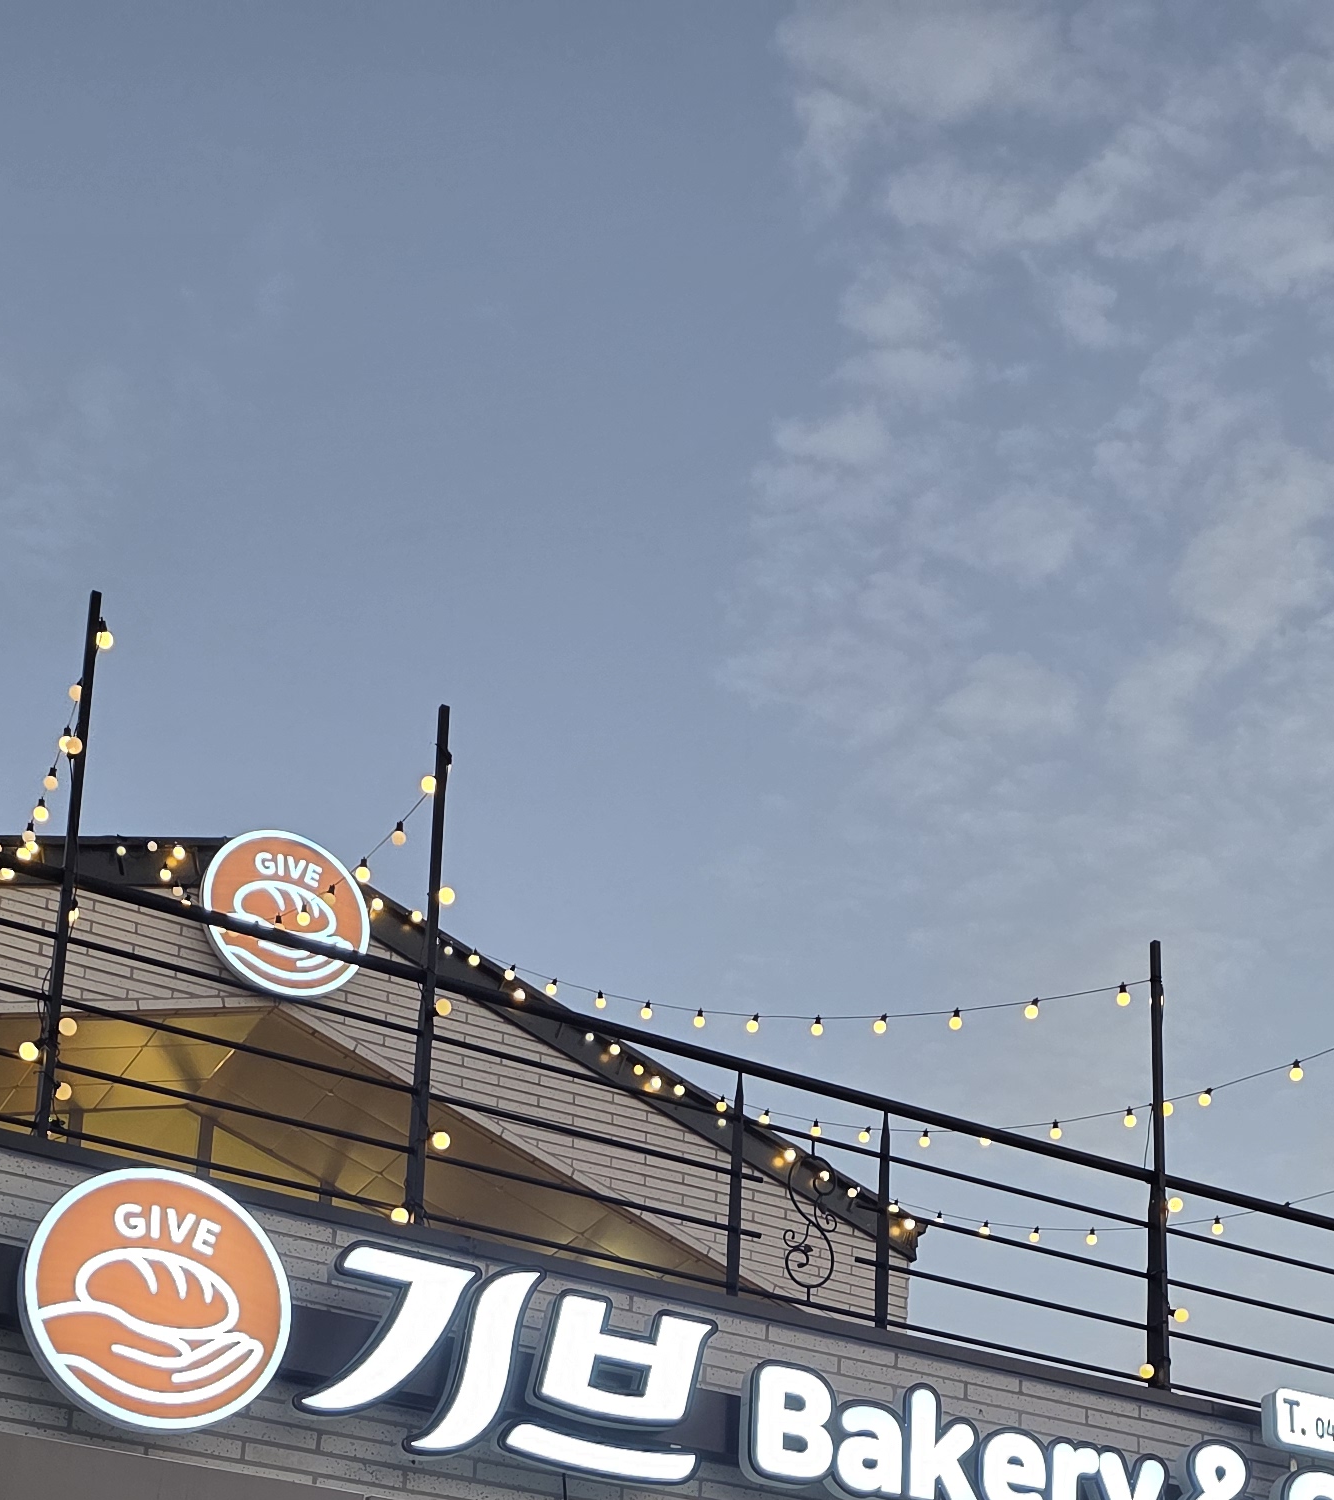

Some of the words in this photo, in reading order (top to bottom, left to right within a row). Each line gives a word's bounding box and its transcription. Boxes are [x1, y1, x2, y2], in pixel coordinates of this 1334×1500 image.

[254, 851, 323, 888] GIVE
[113, 1202, 222, 1256] GIVE
[295, 1244, 716, 1484] 기브
[1282, 1397, 1307, 1436] T.
